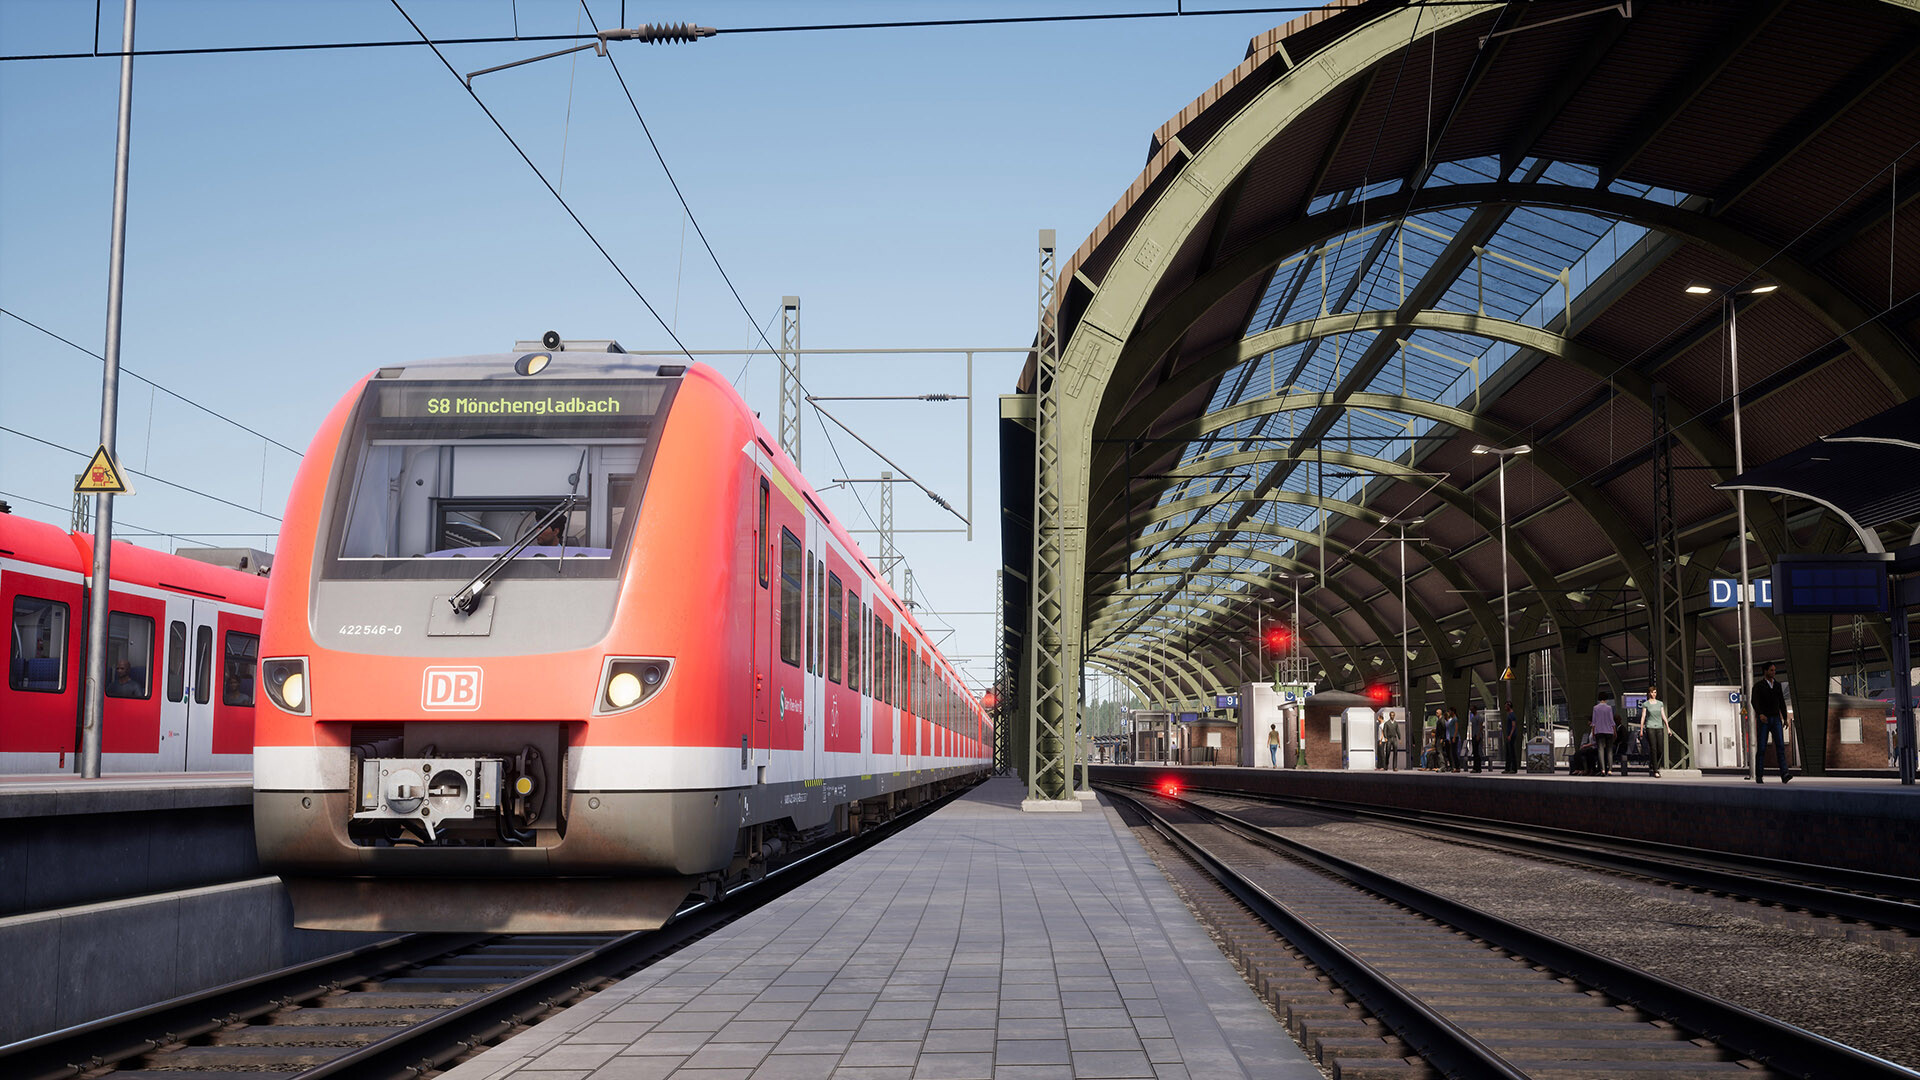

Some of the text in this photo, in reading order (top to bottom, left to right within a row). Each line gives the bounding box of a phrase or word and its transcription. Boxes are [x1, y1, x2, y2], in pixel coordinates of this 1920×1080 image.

[427, 397, 621, 415] S8 Mönchengladbach
[1712, 580, 1732, 603] D
[429, 673, 475, 704] DB
[1226, 695, 1234, 705] 9
[1729, 693, 1738, 703] C
